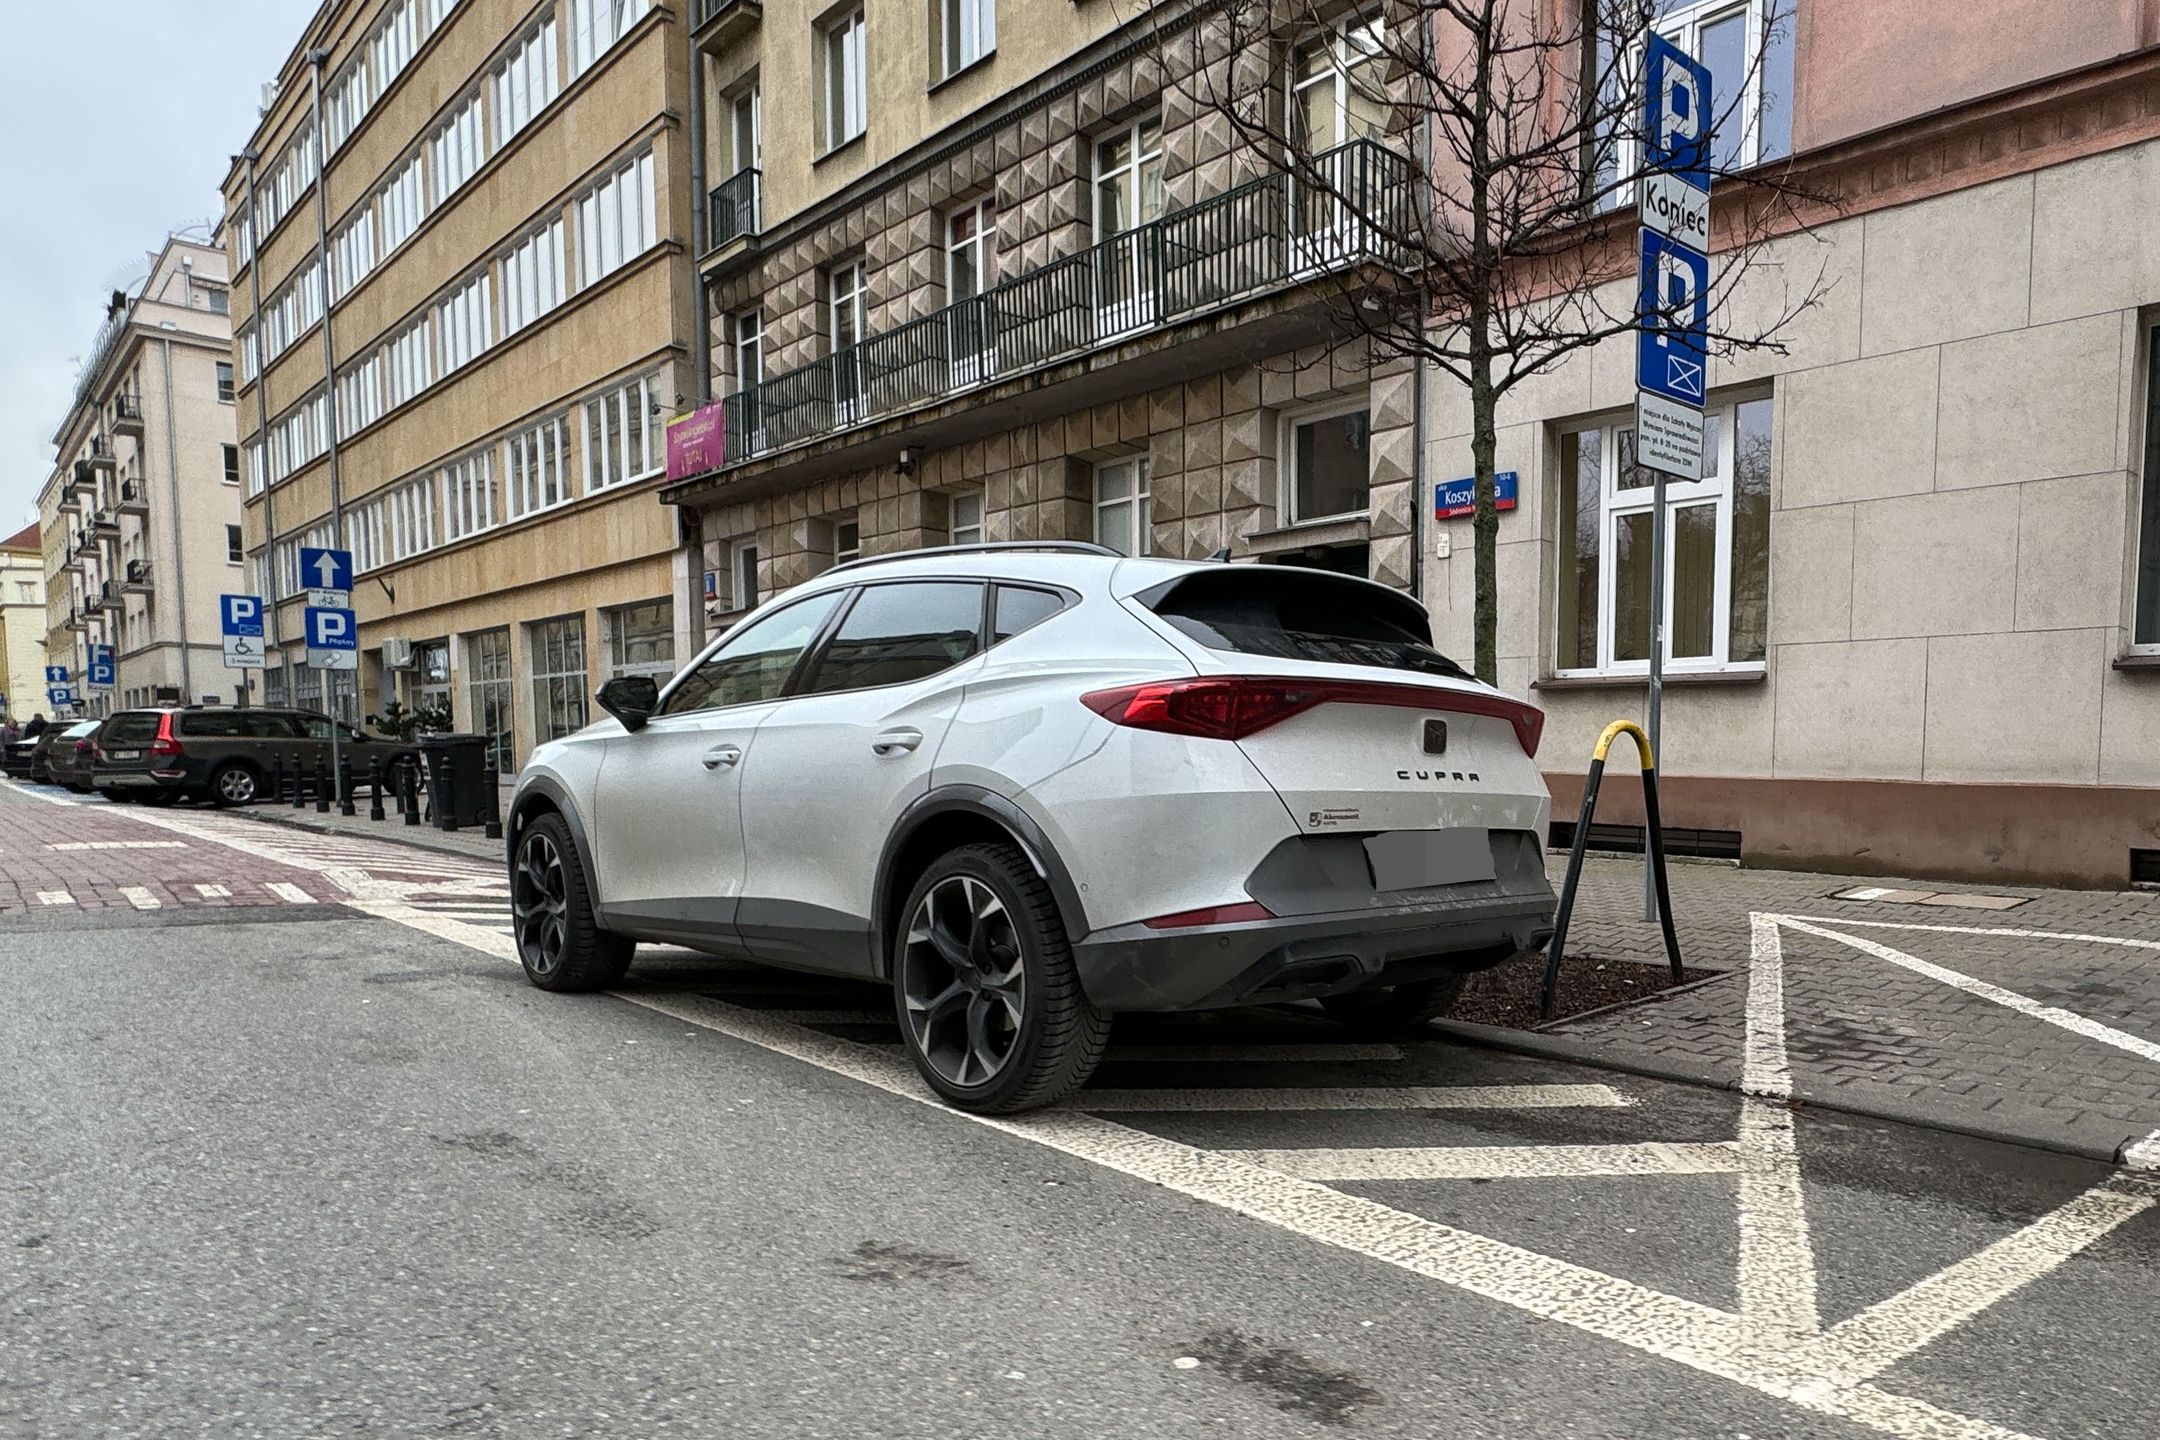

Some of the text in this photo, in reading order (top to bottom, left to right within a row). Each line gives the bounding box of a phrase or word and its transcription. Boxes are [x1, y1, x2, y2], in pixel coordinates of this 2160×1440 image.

[1660, 55, 1699, 156] P
[1645, 179, 1706, 237] Koniec
[1656, 250, 1696, 348] P
[1445, 485, 1501, 506] Koszya
[230, 598, 255, 624] P
[317, 611, 346, 644] P
[94, 665, 110, 681] P
[53, 690, 67, 703] P
[1396, 770, 1480, 782] CUPRA
